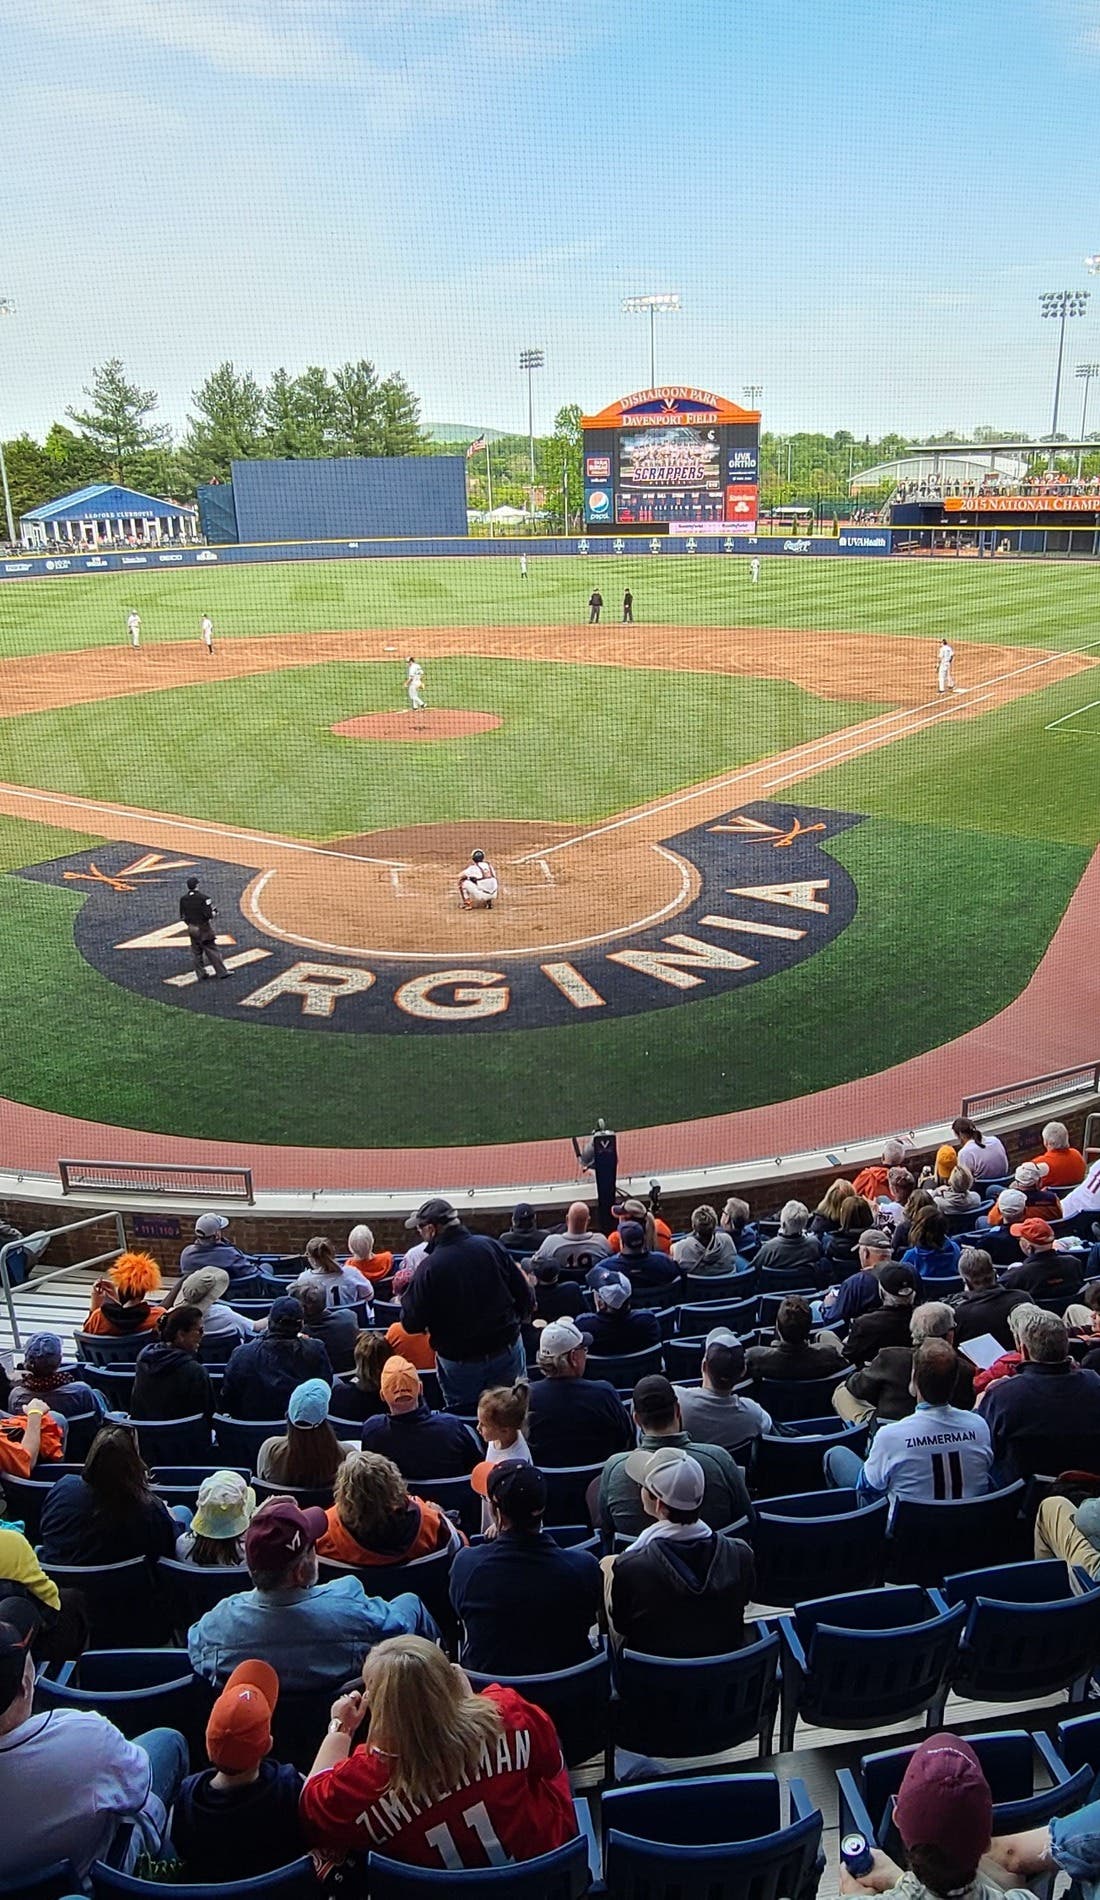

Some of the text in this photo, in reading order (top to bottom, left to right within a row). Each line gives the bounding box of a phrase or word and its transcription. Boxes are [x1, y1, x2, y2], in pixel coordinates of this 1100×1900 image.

[620, 387, 718, 409] DISHAROON PARK
[622, 412, 718, 427] DAVENPORT FIELD
[634, 467, 705, 481] SCRAPPERS
[728, 460, 756, 468] ORTHO
[961, 499, 987, 511] 2015
[989, 499, 1049, 511] NATIONAL
[112, 878, 830, 1021] VIRGINIA
[905, 1430, 976, 1449] ZIMMERMAN
[930, 1450, 964, 1500] 11
[355, 1729, 531, 1845] ZIMMAN
[424, 1800, 516, 1870] 11
